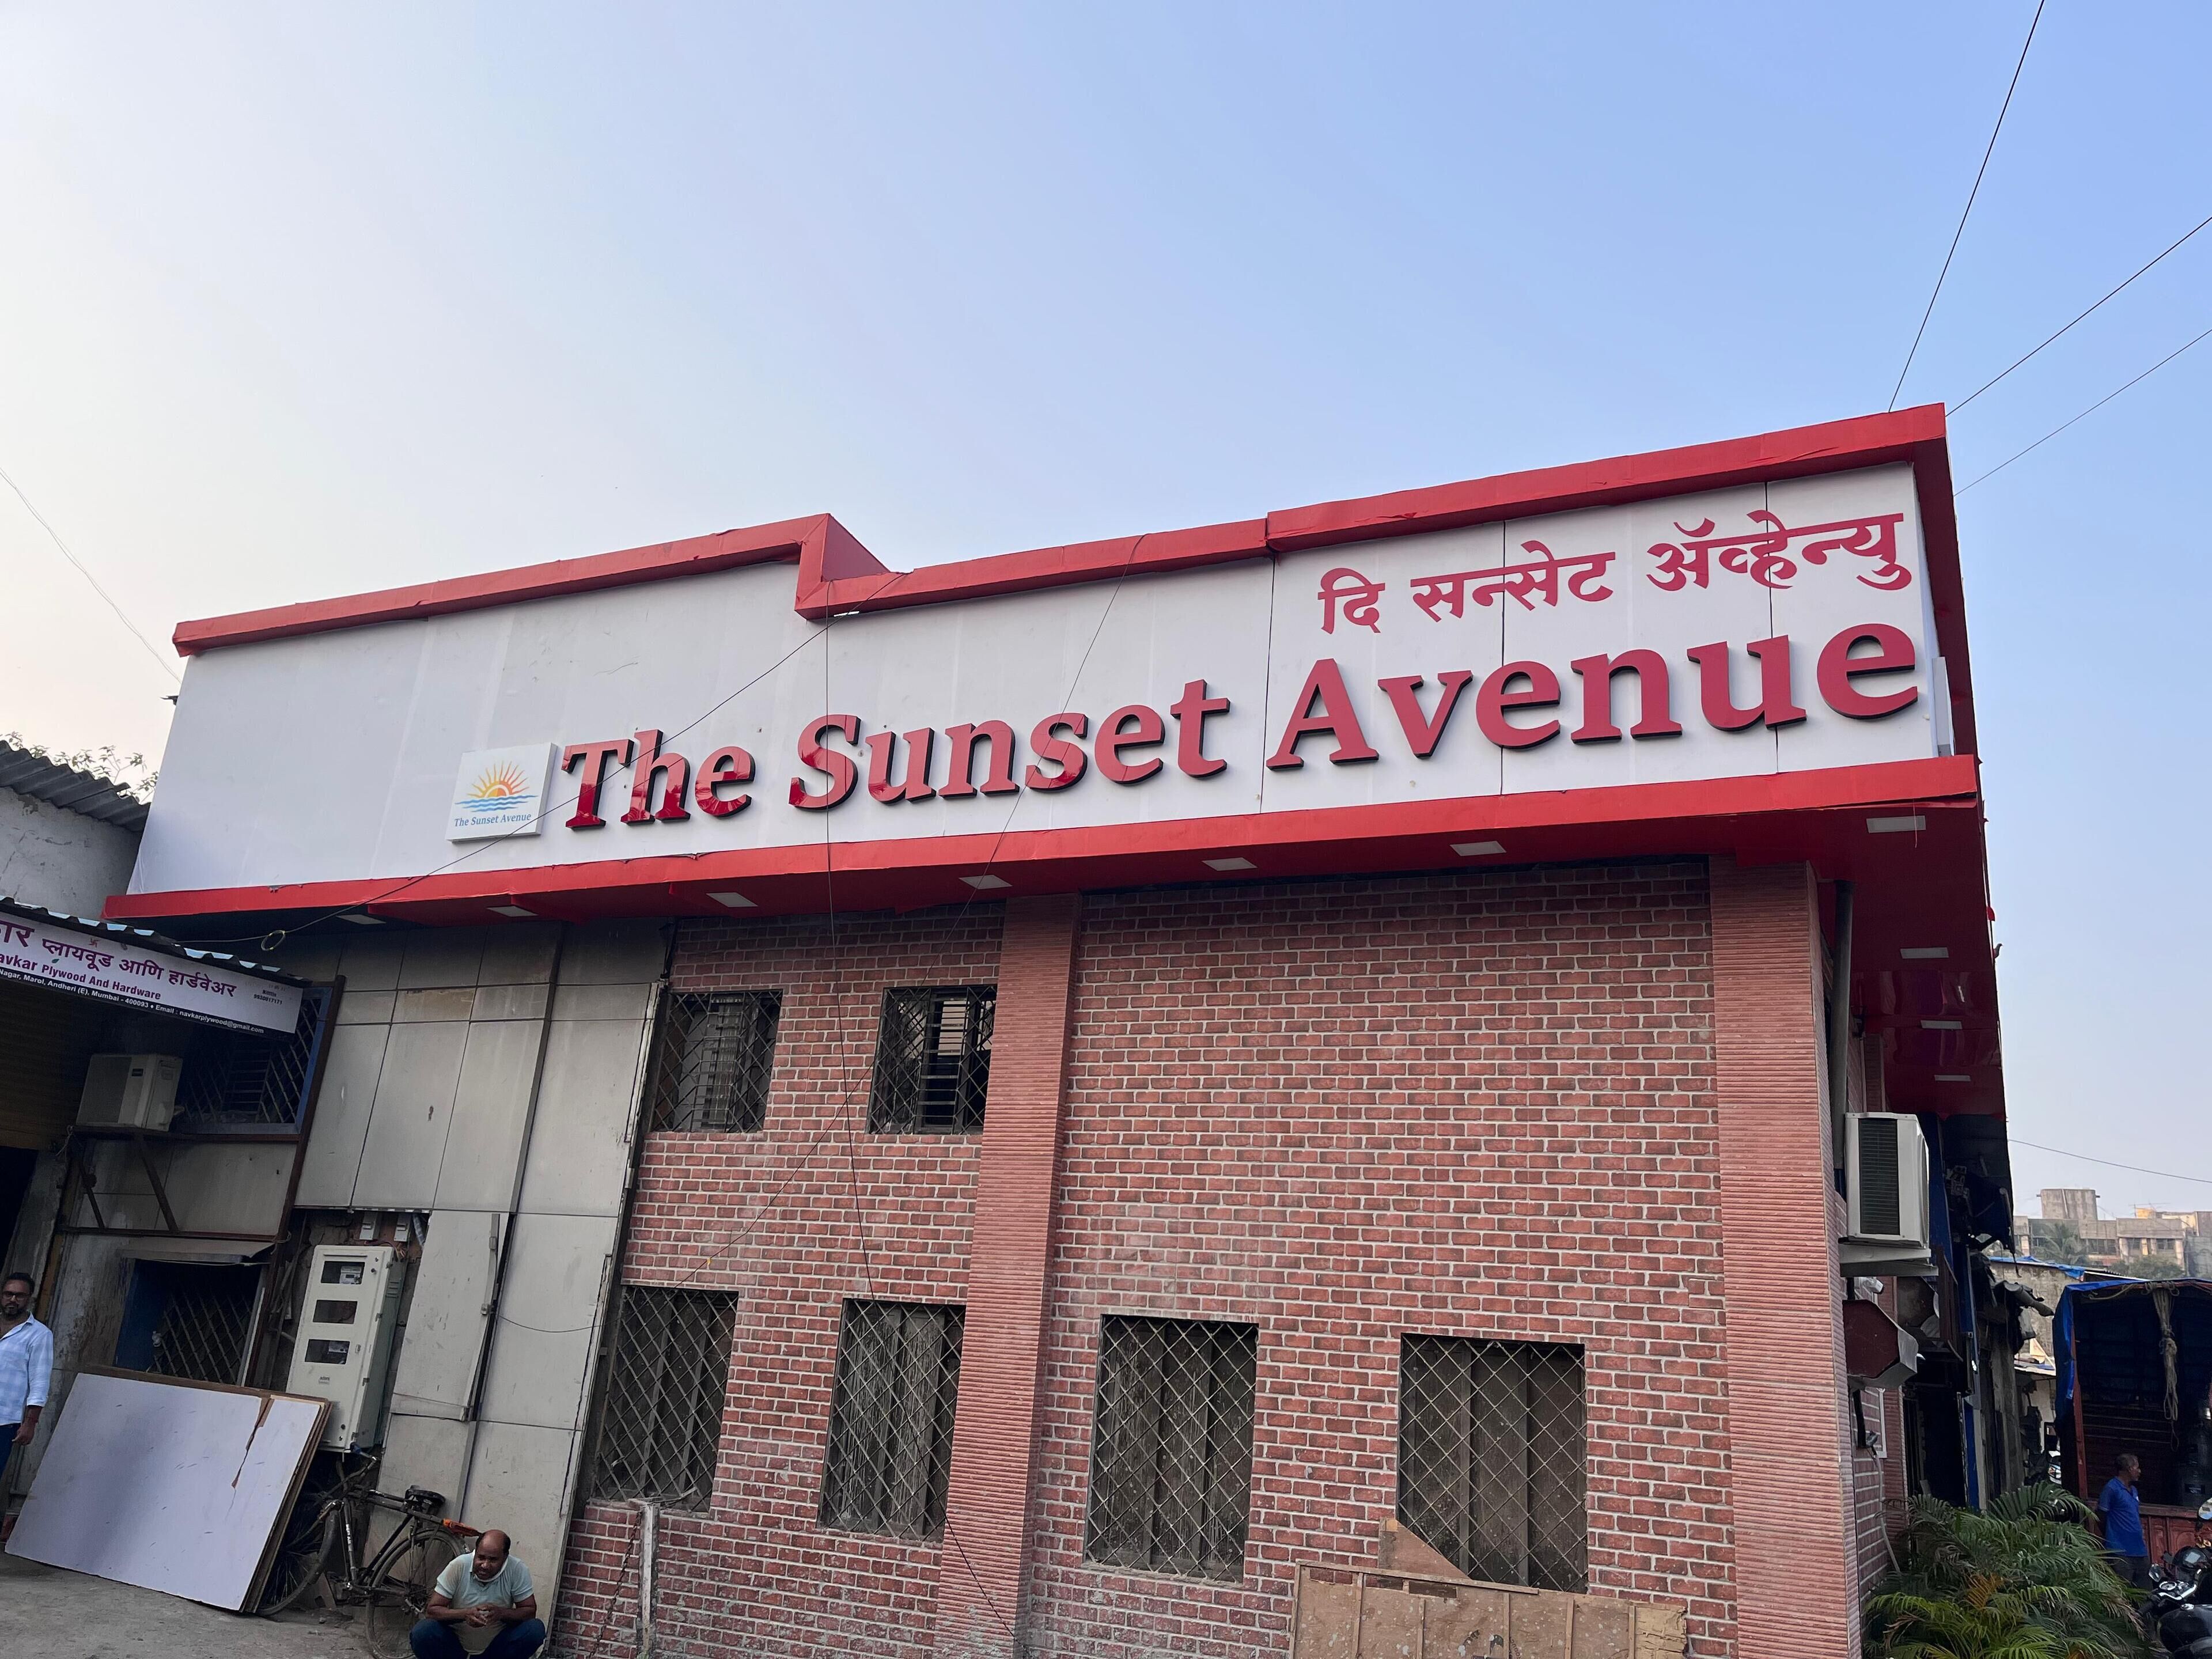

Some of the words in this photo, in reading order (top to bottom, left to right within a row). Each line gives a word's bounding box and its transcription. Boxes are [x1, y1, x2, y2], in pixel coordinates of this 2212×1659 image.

[1317, 567, 1385, 634] दि
[1411, 540, 1616, 623] सन्सेट
[562, 730, 756, 829] The
[788, 679, 1231, 811] Sunset
[1264, 622, 1919, 772] Avenue
[454, 817, 469, 827] The
[471, 816, 498, 825] Sunset
[500, 813, 531, 823] Avenue
[0, 921, 35, 948] ार
[42, 938, 115, 972] प्लायवूड
[119, 959, 165, 980] आणि
[169, 969, 237, 997] हार्डवेअर
[0, 953, 38, 971] avkar
[41, 964, 86, 983] Plywood
[89, 976, 109, 988] And
[112, 981, 161, 1000] Hardware
[24, 974, 46, 985] Marol,
[47, 980, 76, 991] Andheri
[92, 990, 119, 1002] Mumbai
[125, 996, 149, 1007] 400093
[156, 1005, 175, 1014] Email
[179, 1010, 264, 1033] navkarplywood@gmail.com
